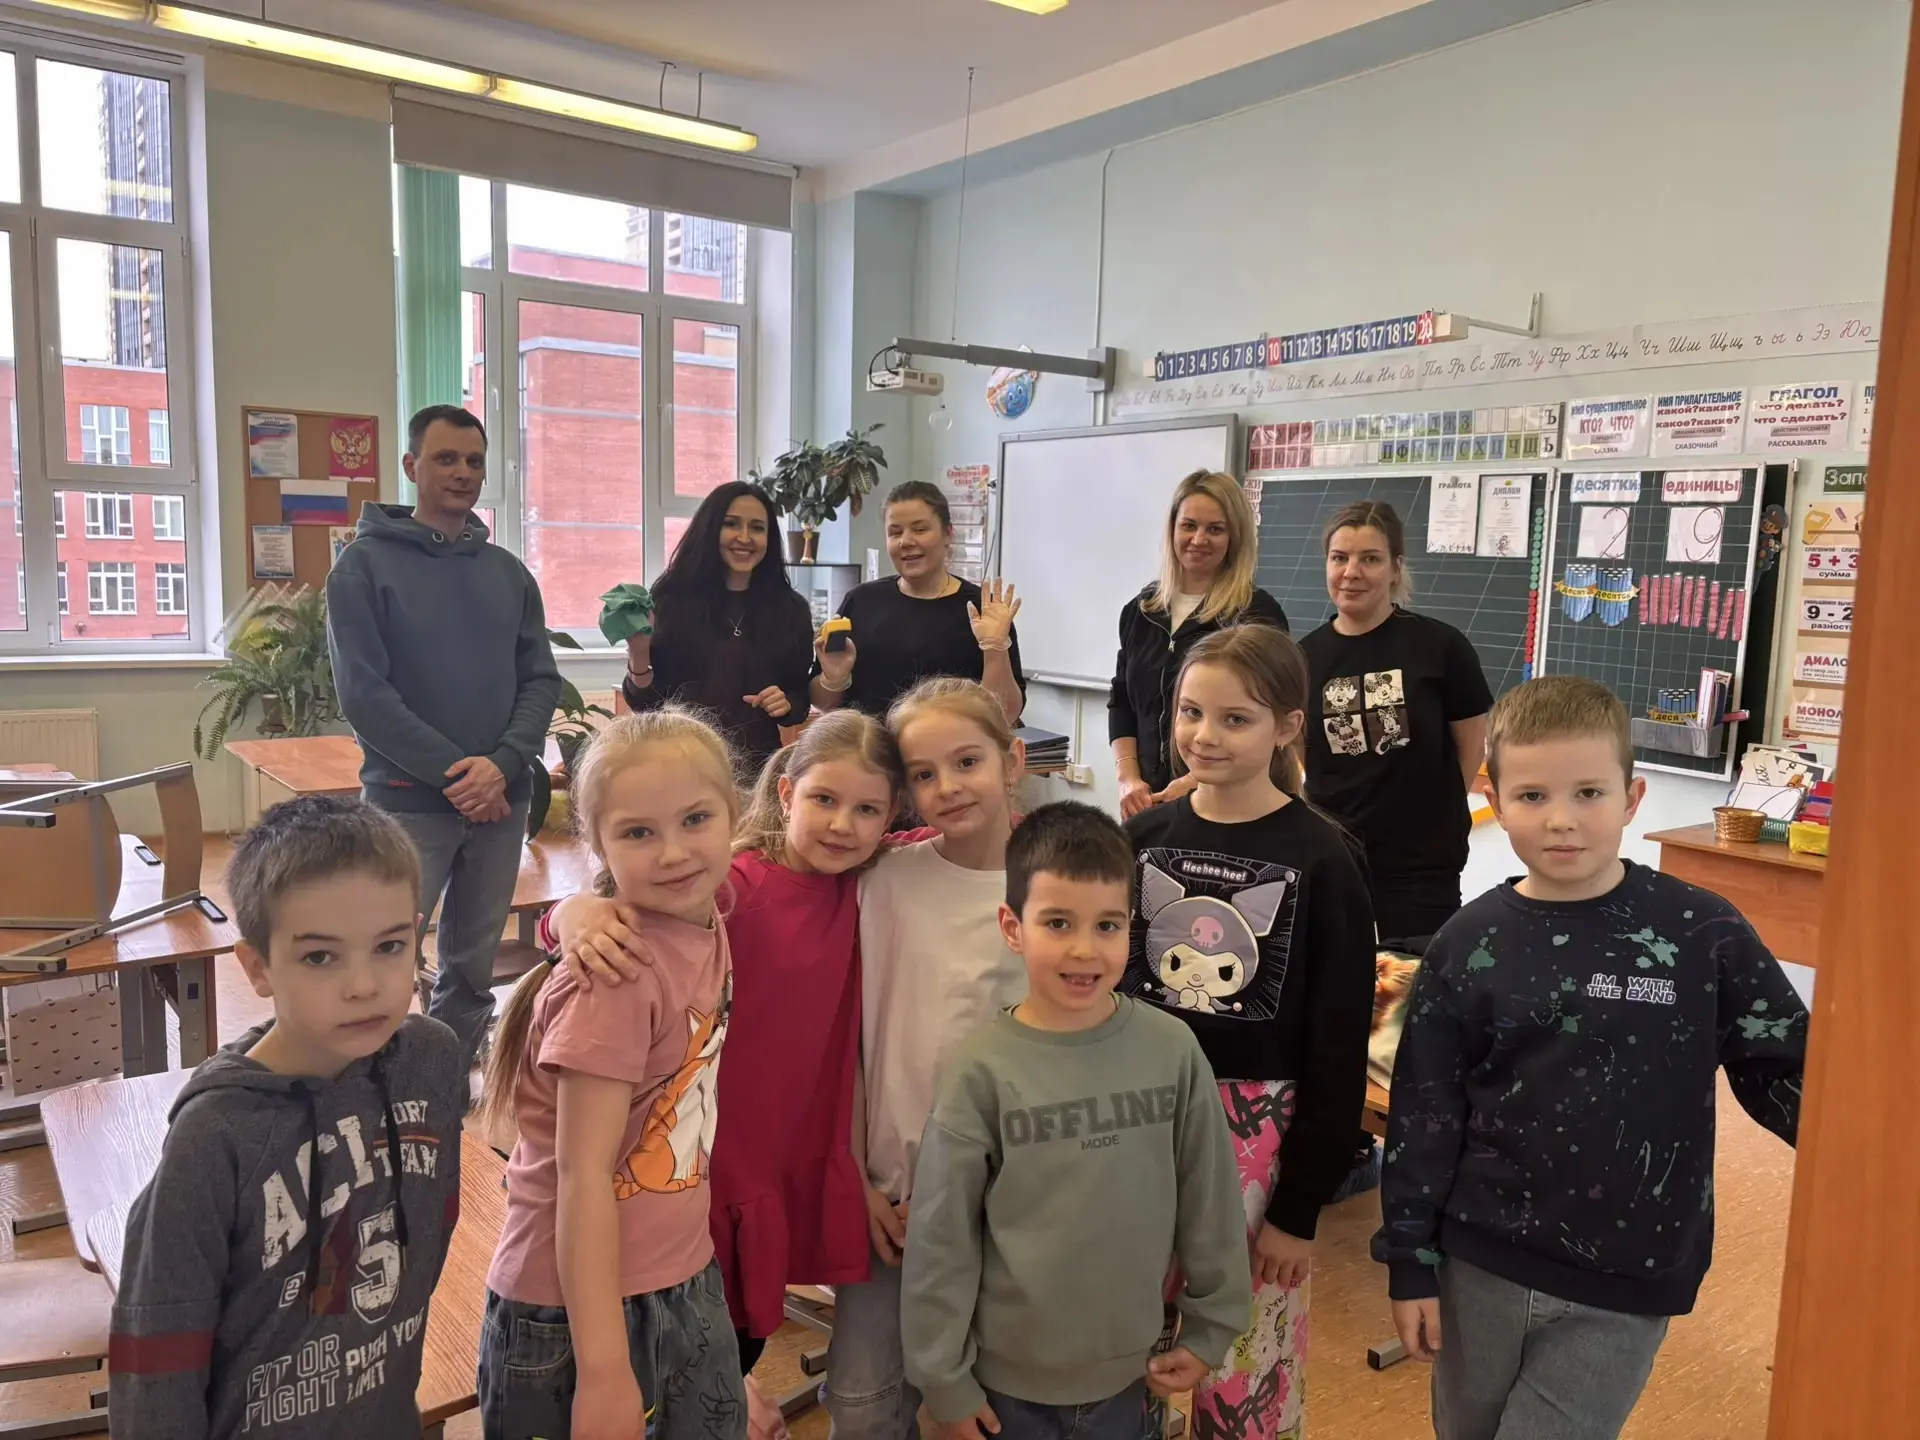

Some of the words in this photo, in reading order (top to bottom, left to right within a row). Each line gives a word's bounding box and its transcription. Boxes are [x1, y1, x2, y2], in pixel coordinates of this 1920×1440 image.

[1157, 360, 1164, 377] 0
[1168, 356, 1174, 376] 1
[1178, 358, 1185, 375] 2
[1188, 356, 1196, 373] 3
[1200, 355, 1207, 371] 4
[1211, 352, 1218, 369] 5
[1222, 350, 1230, 368] 6
[1234, 348, 1241, 366] 7
[1245, 346, 1253, 364] 8
[1258, 344, 1265, 363] 9
[1268, 342, 1279, 361] 10
[1282, 340, 1293, 359] 11
[1296, 338, 1307, 357] 12
[1310, 336, 1322, 355] 13
[1325, 333, 1338, 353] 14
[1340, 331, 1352, 351] 15
[1355, 328, 1369, 349] 16
[1371, 326, 1384, 346] 17
[1386, 323, 1400, 344] 18
[1402, 321, 1416, 342] 19
[1418, 318, 1432, 343] 20
[1422, 360, 1443, 377] Пп
[1447, 358, 1466, 380] Рр
[1470, 355, 1485, 372] Сс
[1490, 351, 1522, 370] Тт
[1527, 349, 1545, 373] Уу
[1548, 346, 1570, 368] Фф
[1575, 344, 1600, 361] Хх
[1605, 341, 1629, 359] Цц
[1639, 339, 1660, 356] Чч
[1668, 336, 1702, 354] Шш
[1709, 332, 1743, 352] Щщ
[1811, 323, 1831, 341] Ээ
[1839, 319, 1872, 339] Юю
[1658, 396, 1674, 408] ИМЯ
[1675, 390, 1742, 406] ПРИЛАГАТЕЛЬНОЕ
[1769, 386, 1838, 401] ГЛАГОЛ
[1786, 399, 1844, 412] делать?
[1579, 417, 1603, 434] КТО?
[1610, 415, 1634, 432] ЧТО?
[1754, 416, 1776, 424] что
[1781, 412, 1847, 424] сделать?
[1397, 443, 1408, 461] Ф
[1675, 441, 1718, 450] СКАЗОЧНЫЙ
[1768, 439, 1827, 448] РАССКАЗЫВАТЬ
[1493, 487, 1521, 496] ДИПЛОМ
[1575, 478, 1638, 493] десятки
[1666, 480, 1739, 494] единицы
[1600, 507, 1629, 559] 2
[1686, 507, 1723, 562] 9
[1808, 553, 1821, 568] 5
[1807, 605, 1820, 620] 9
[1223, 868, 1246, 882] hee!
[1591, 973, 1617, 987] I'M
[1628, 976, 1674, 993] WITH
[1587, 984, 1622, 999] THE
[1626, 987, 1677, 1004] BAND
[1003, 1084, 1177, 1147] OFFLINE
[1081, 1134, 1121, 1150] MODE
[345, 1330, 388, 1376] PUSH
[246, 1355, 292, 1402] FIT
[297, 1333, 340, 1377] OR
[346, 1359, 385, 1404] LIMIT
[242, 1369, 340, 1432] FIGHT
